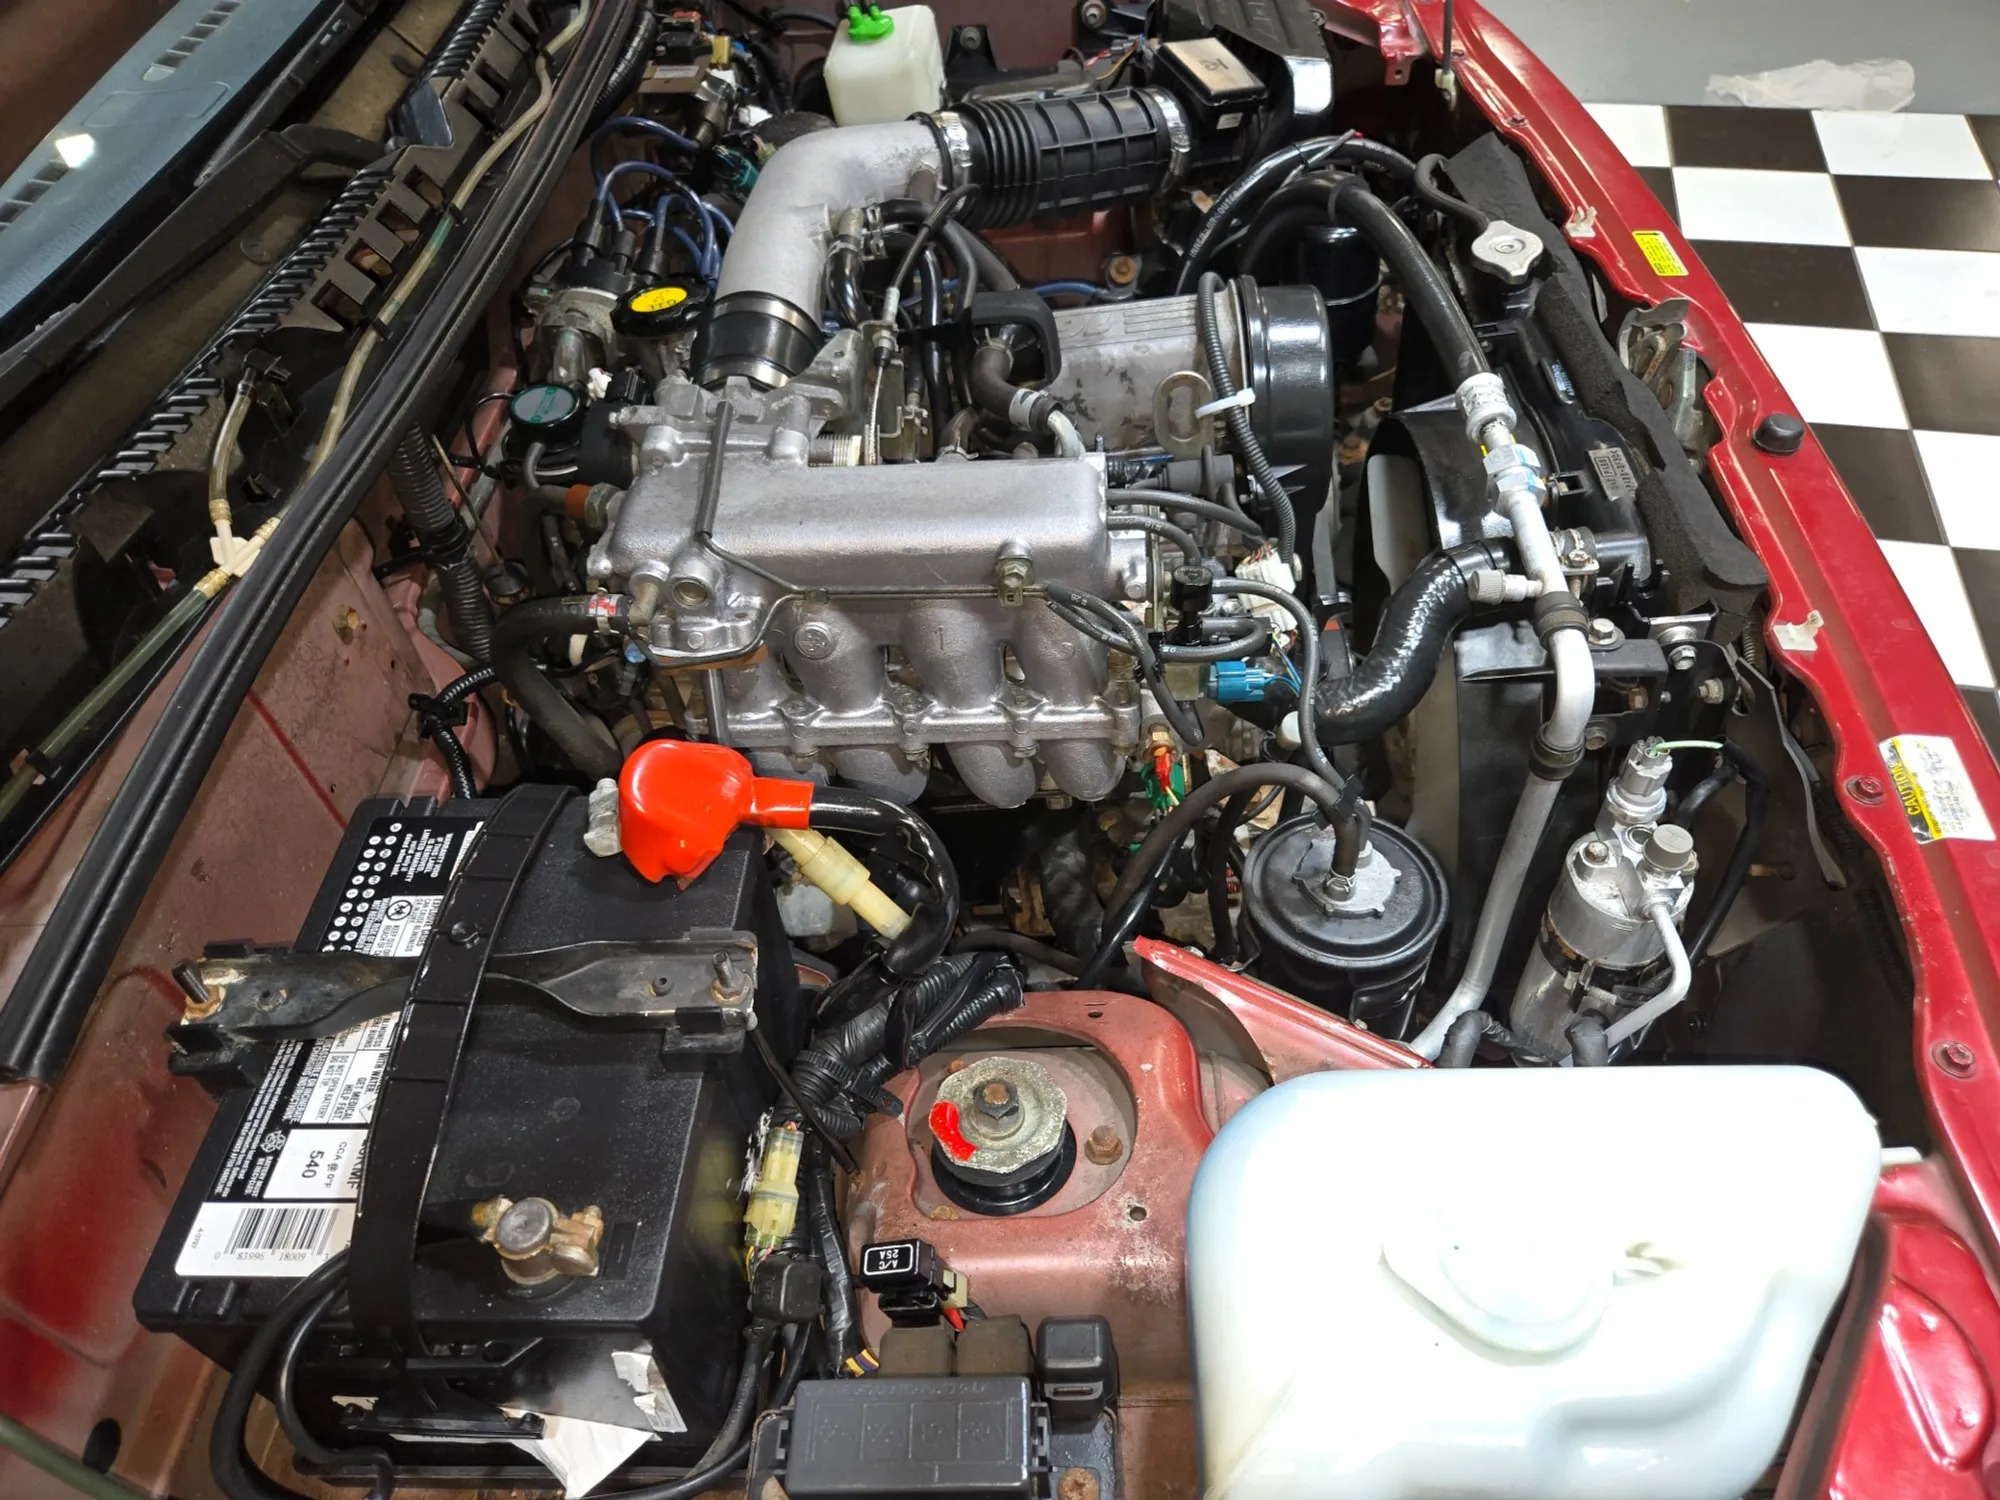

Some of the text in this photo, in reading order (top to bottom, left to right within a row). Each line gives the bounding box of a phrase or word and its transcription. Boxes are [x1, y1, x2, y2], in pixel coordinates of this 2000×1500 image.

[1891, 762, 1921, 816] CAUTION
[334, 1141, 347, 1161] CCA
[301, 1150, 325, 1179] 540
[236, 1252, 265, 1261] 83996
[278, 1252, 307, 1261] 18009
[880, 1249, 899, 1260] 25A
[878, 1260, 898, 1270] A/C
